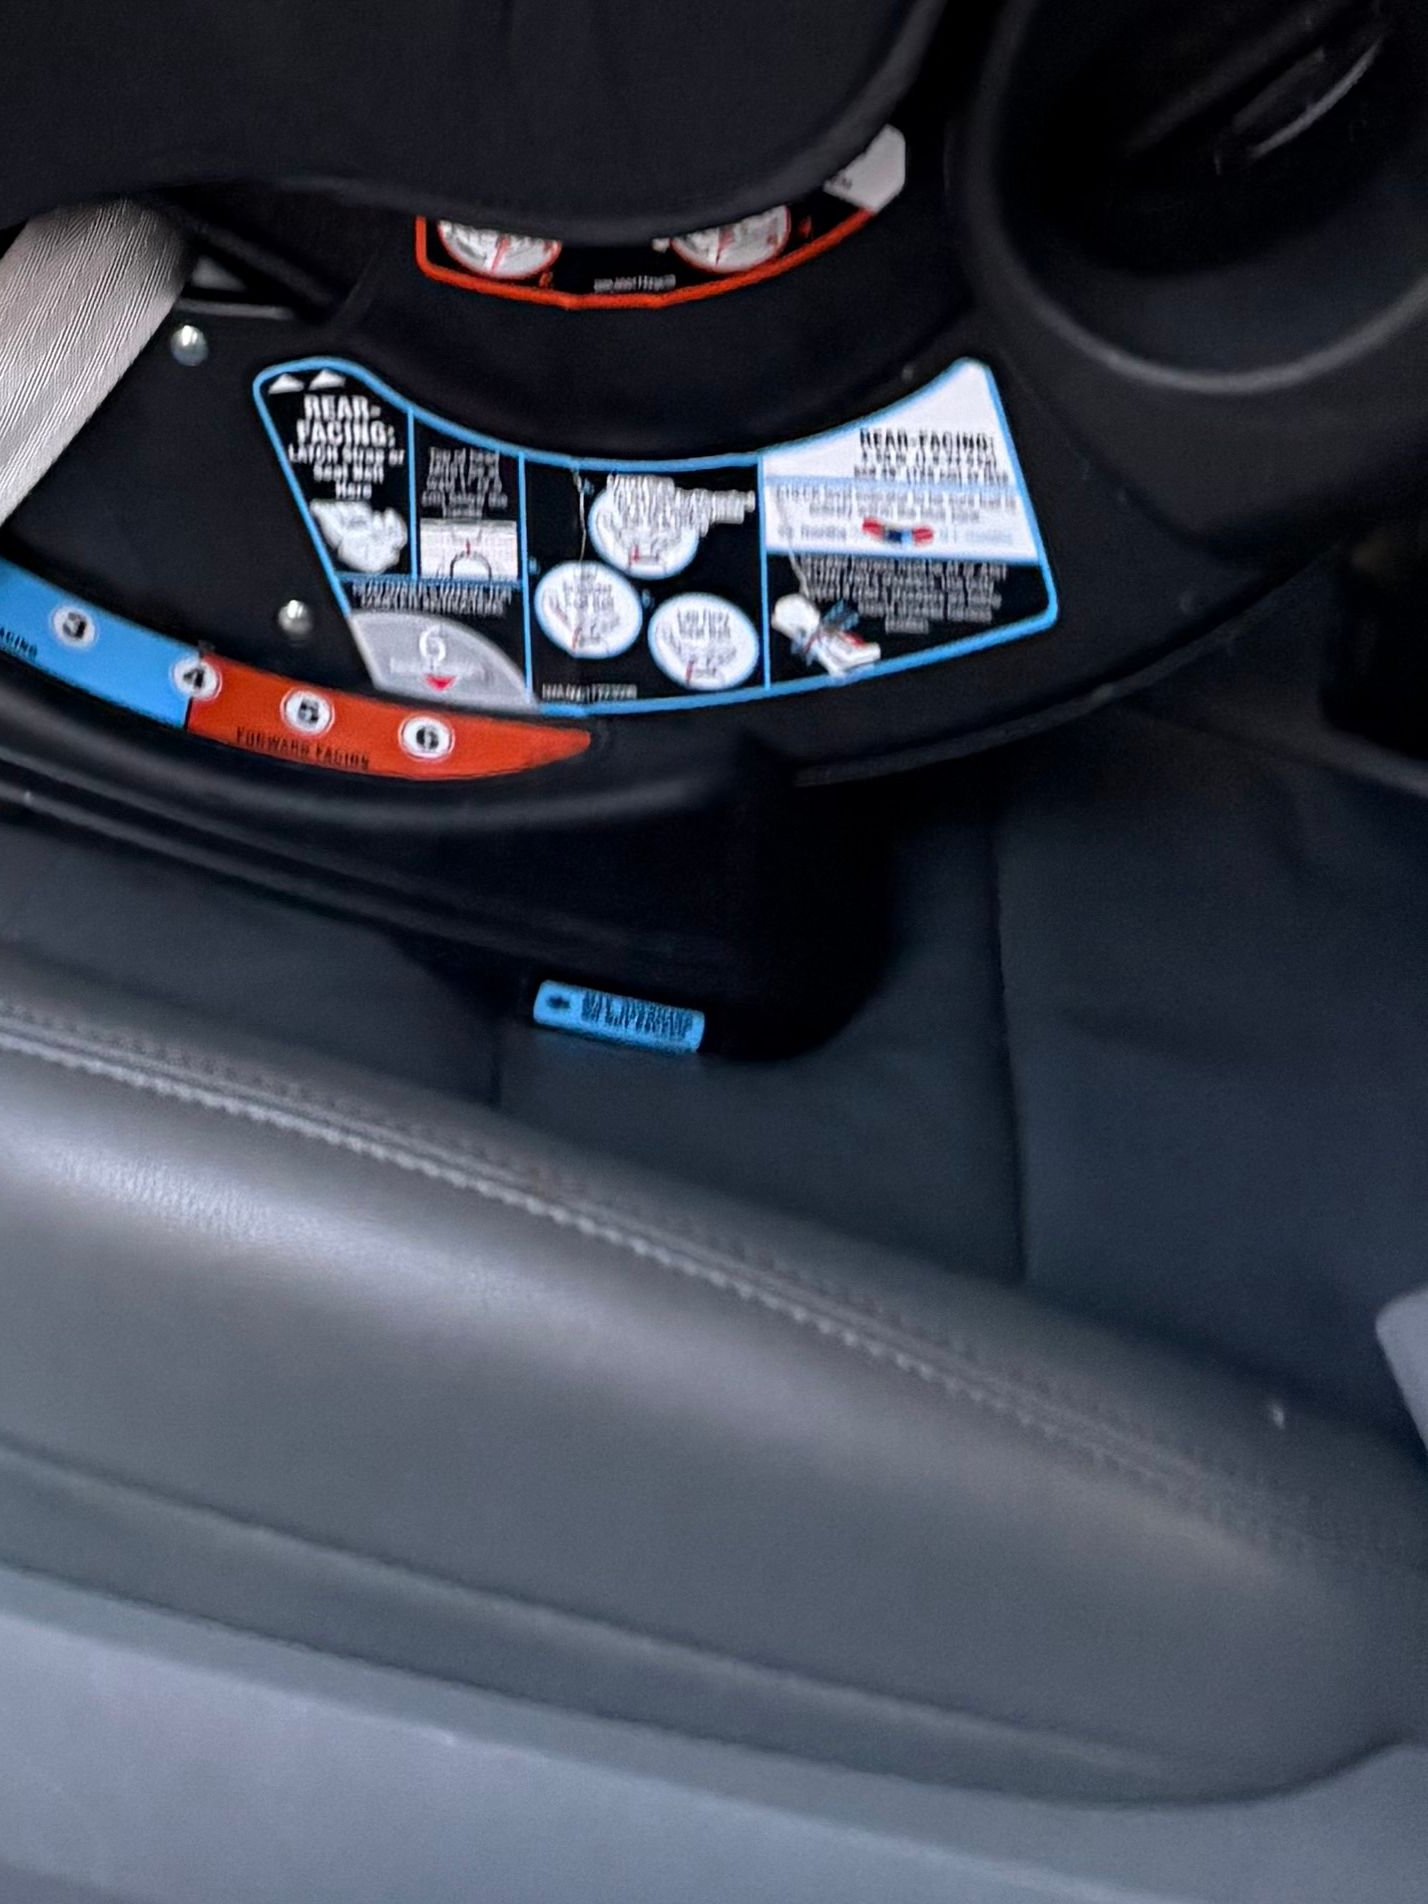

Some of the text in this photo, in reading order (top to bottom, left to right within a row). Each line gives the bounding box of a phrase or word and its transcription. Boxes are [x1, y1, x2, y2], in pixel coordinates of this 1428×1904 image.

[304, 395, 381, 421] REAR-
[63, 612, 87, 640] 3
[182, 665, 206, 689] 4
